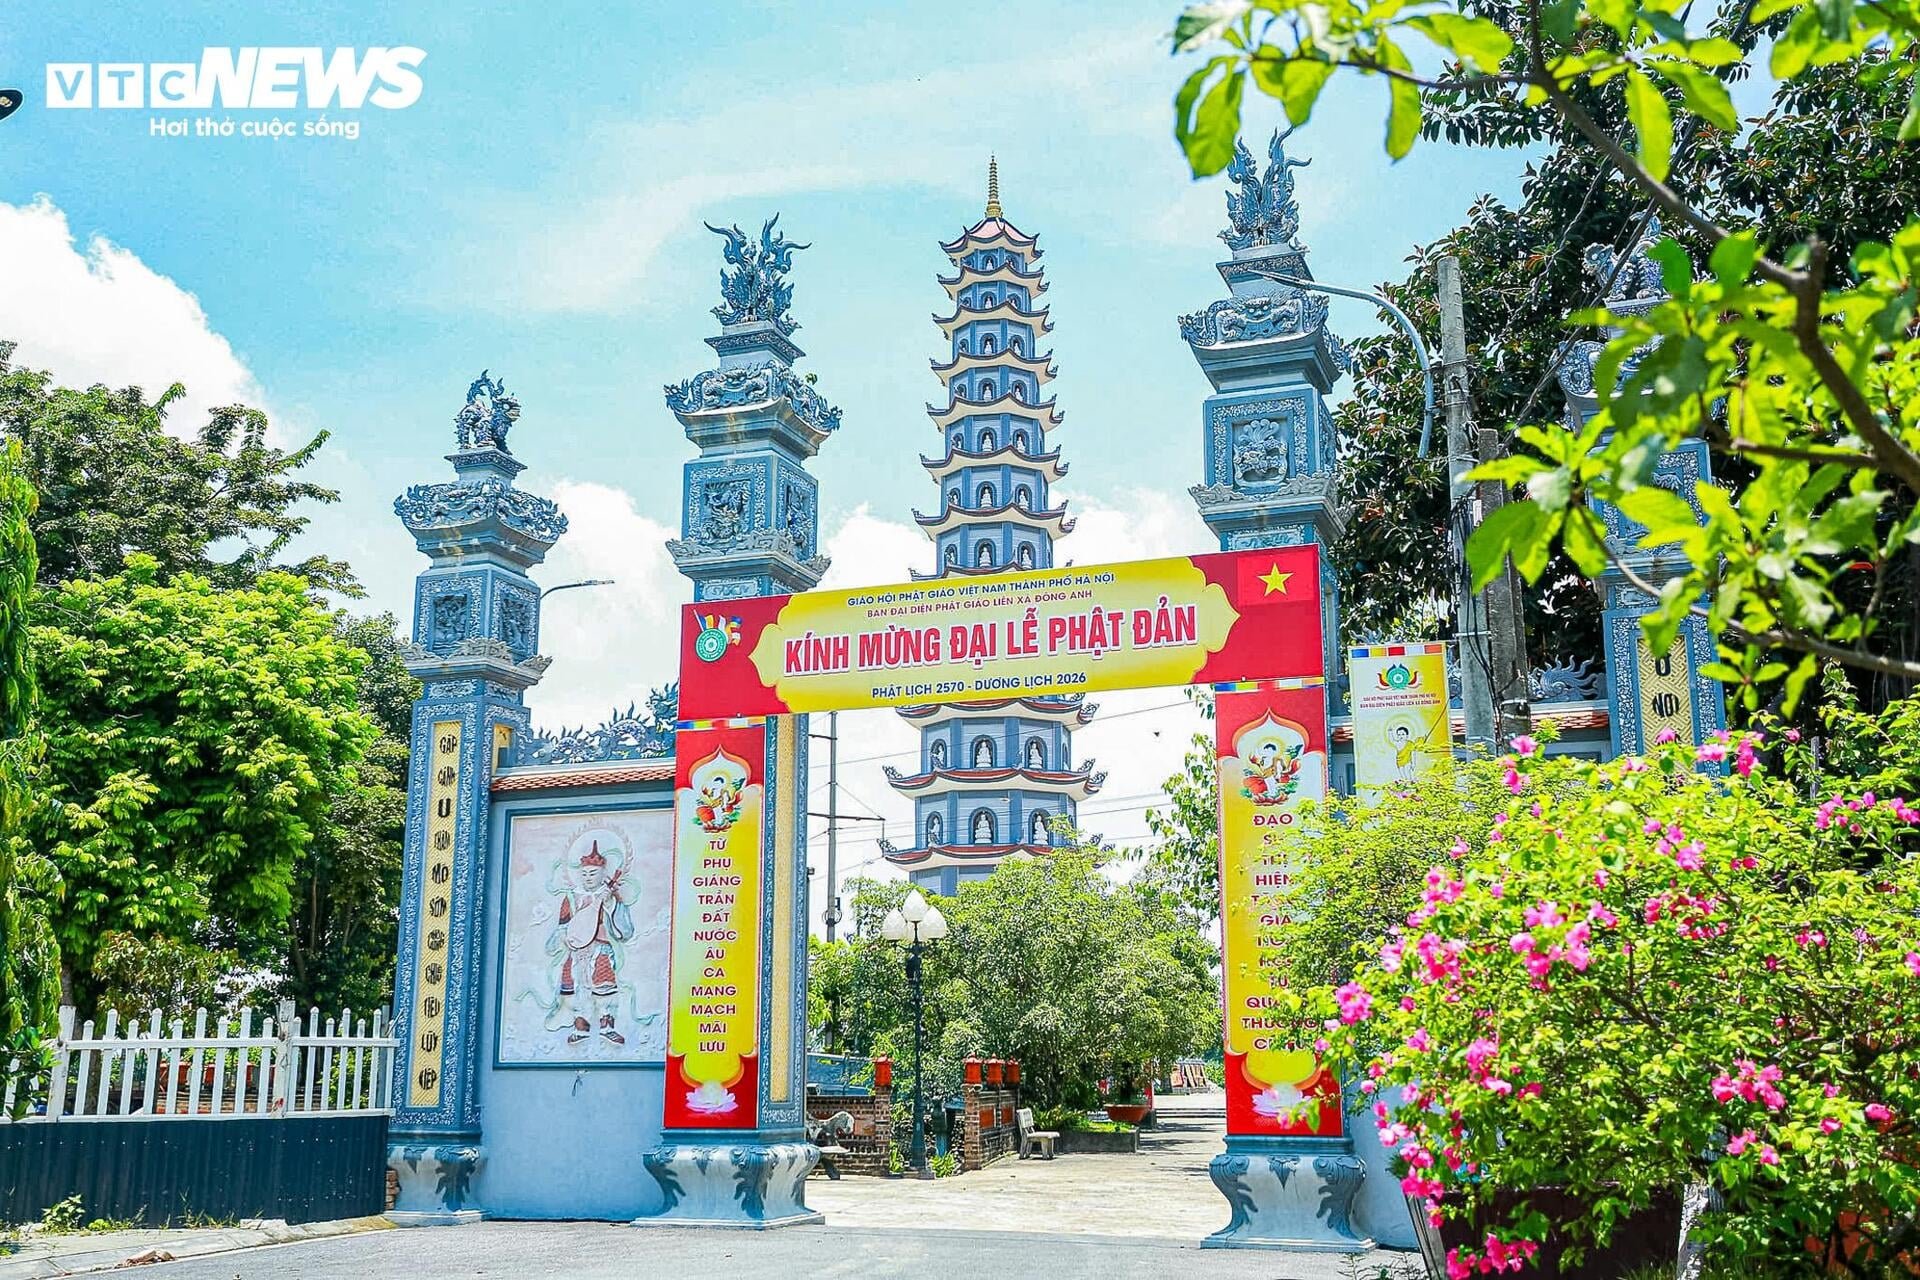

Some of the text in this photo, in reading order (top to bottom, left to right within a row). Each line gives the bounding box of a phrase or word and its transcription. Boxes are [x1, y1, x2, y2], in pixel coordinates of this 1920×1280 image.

[847, 572, 1115, 606] GIÁO HỘI PHẬT GIÁO VIỆT NAM THÀNH PHỐ HÀ NỘI
[867, 609, 888, 618] BAN
[963, 597, 991, 609] GIÁO
[1069, 590, 1092, 599] ANH
[785, 596, 1197, 674] KÍNH MỪNG ĐẠI LỄ PHẬT ĐẢN
[872, 683, 902, 700] PHẬT
[905, 684, 932, 698] LỊCH
[935, 680, 965, 693] 2570
[975, 676, 1021, 691] DƯƠNG
[1024, 675, 1052, 690] LỊCH
[1056, 672, 1086, 685] 2026
[1253, 813, 1293, 828] ĐẠO
[709, 837, 727, 851] TỪ
[703, 858, 731, 871] PHỤ
[692, 874, 741, 887] GIÁNG
[702, 908, 730, 923] ĐẤT
[694, 927, 737, 941] NƯỚC
[705, 946, 725, 959] ÂU
[703, 967, 725, 978] CA
[691, 986, 737, 999] MẠNG
[691, 1004, 736, 1018] MẠCH
[699, 1020, 727, 1033] MÃI
[699, 1040, 725, 1052] LƯU
